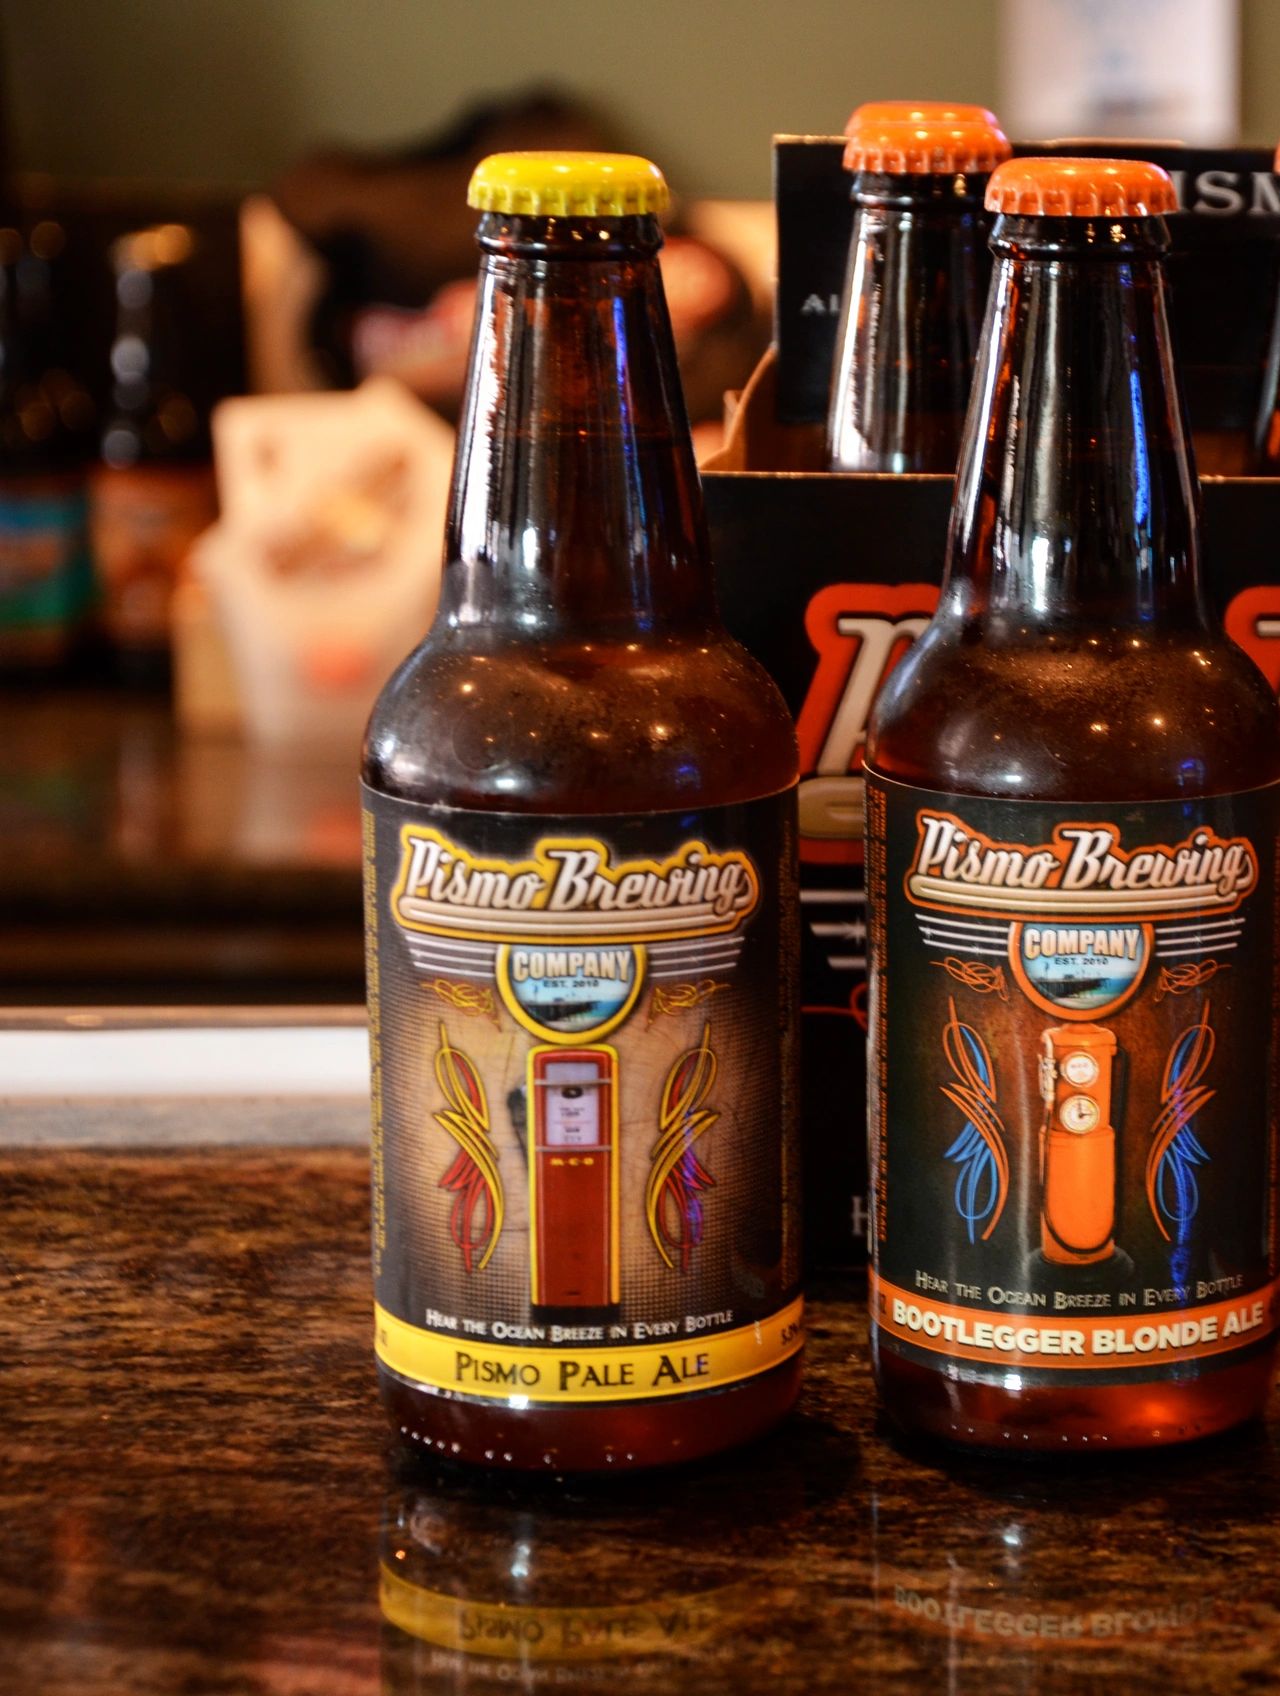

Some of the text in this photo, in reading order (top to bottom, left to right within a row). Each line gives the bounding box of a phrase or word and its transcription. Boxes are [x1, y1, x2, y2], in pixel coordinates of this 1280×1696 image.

[407, 837, 753, 916] Pismo Brewing
[919, 817, 1252, 896] Pismo Brewing
[1024, 928, 1140, 961] COMPANY
[512, 950, 632, 982] COMPANY
[915, 1270, 1244, 1310] HEAR THE OCEAN BREEZE IN EVERY BOTTLE
[426, 1308, 735, 1342] HEAR THE OCEAN BREEZE IN EVERY BOTTLE
[892, 1298, 1084, 1355] BOOTLEGGER
[1091, 1317, 1218, 1355] BLONDE
[1222, 1303, 1264, 1337] ALE
[455, 1351, 710, 1391] PISMO PALE ALE
